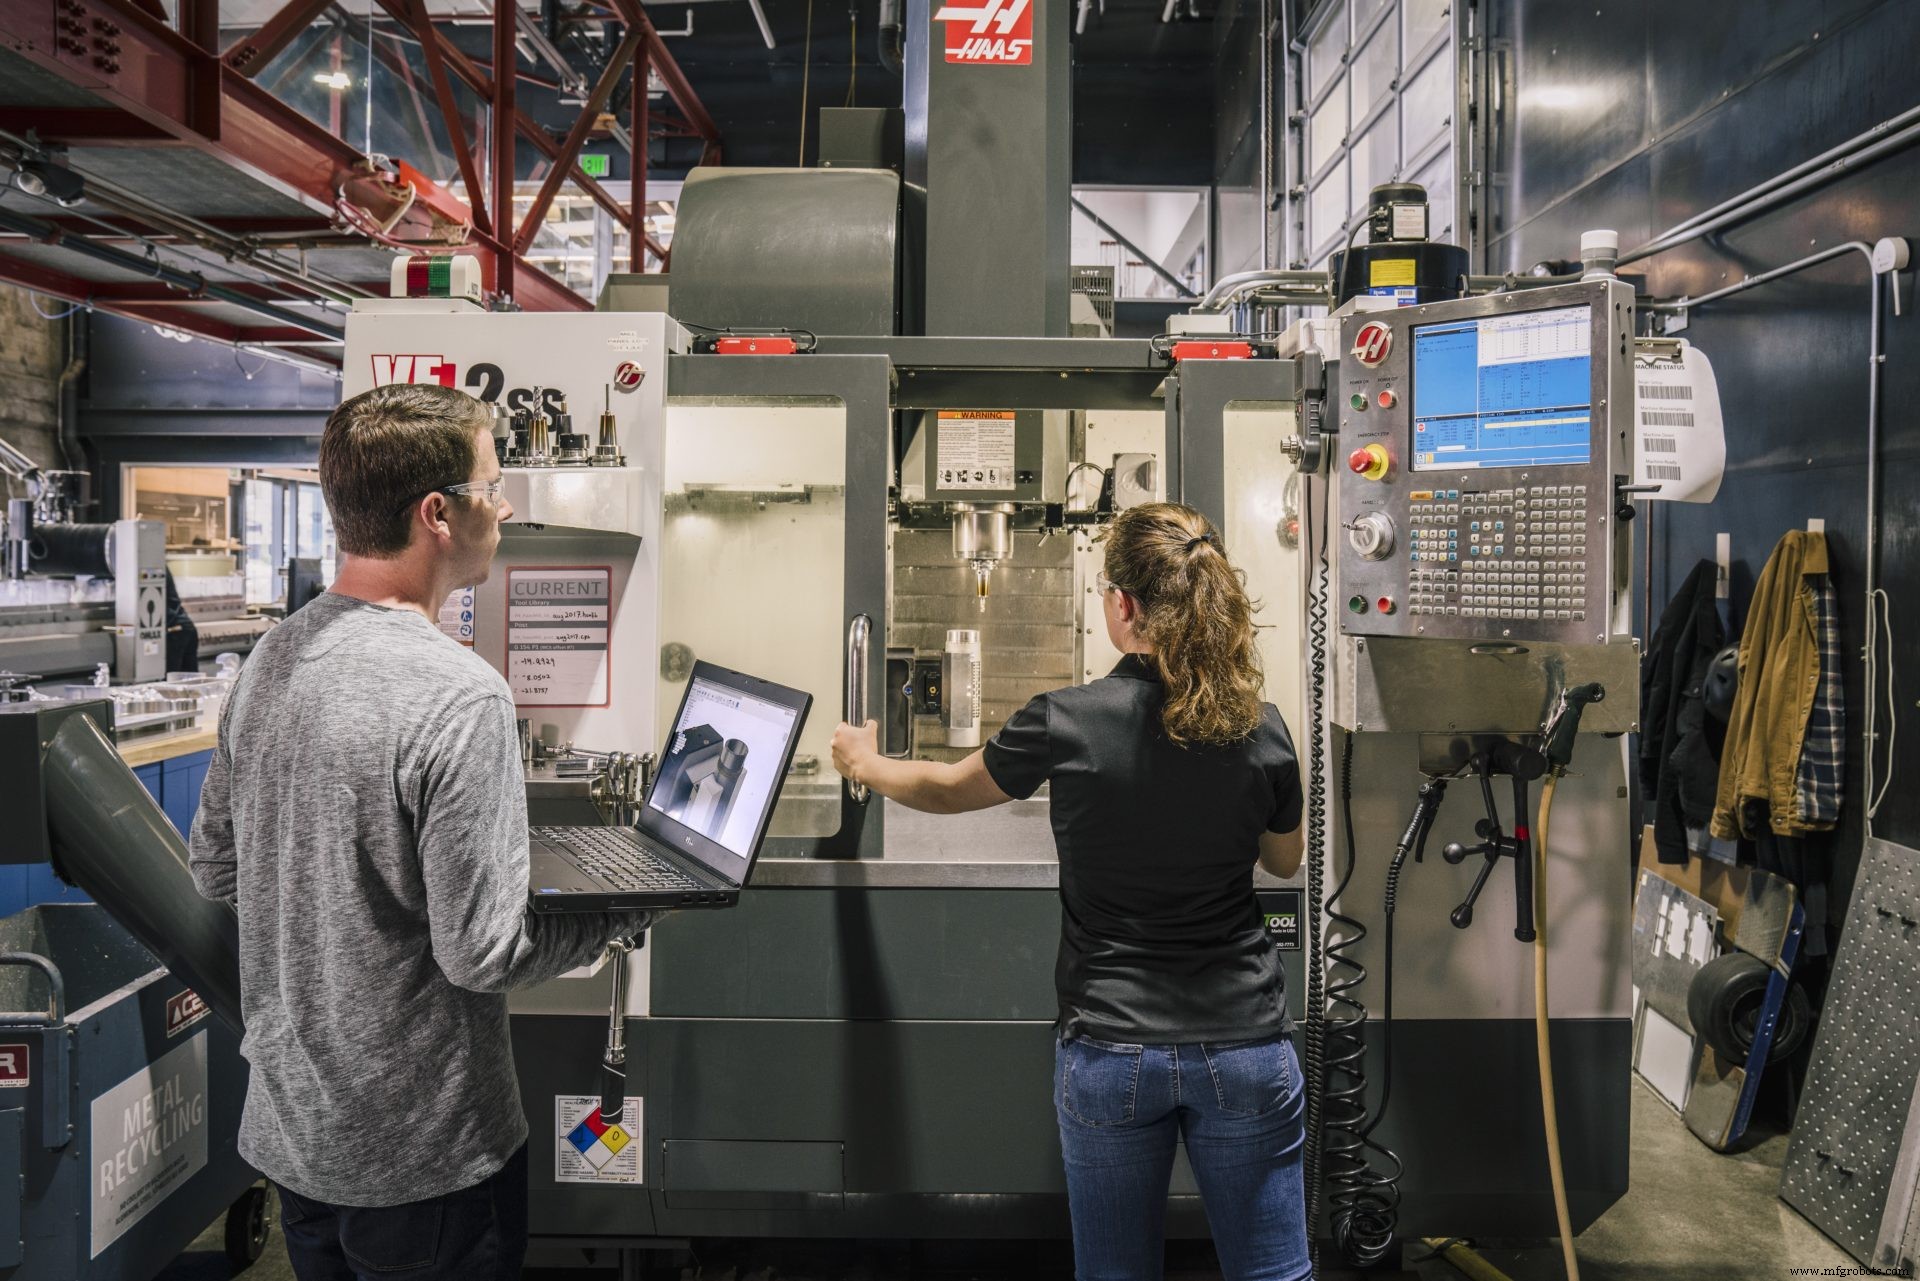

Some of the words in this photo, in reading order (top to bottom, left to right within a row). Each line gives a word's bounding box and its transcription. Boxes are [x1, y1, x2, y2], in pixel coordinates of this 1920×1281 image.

[945, 38, 1032, 60] HAAS
[515, 581, 602, 596] CURRENT
[1263, 914, 1297, 928] TOOL
[172, 992, 207, 1024] ACE
[123, 1074, 184, 1143] METAL
[101, 1093, 202, 1198] RECYCLING
[613, 1131, 620, 1141] 0
